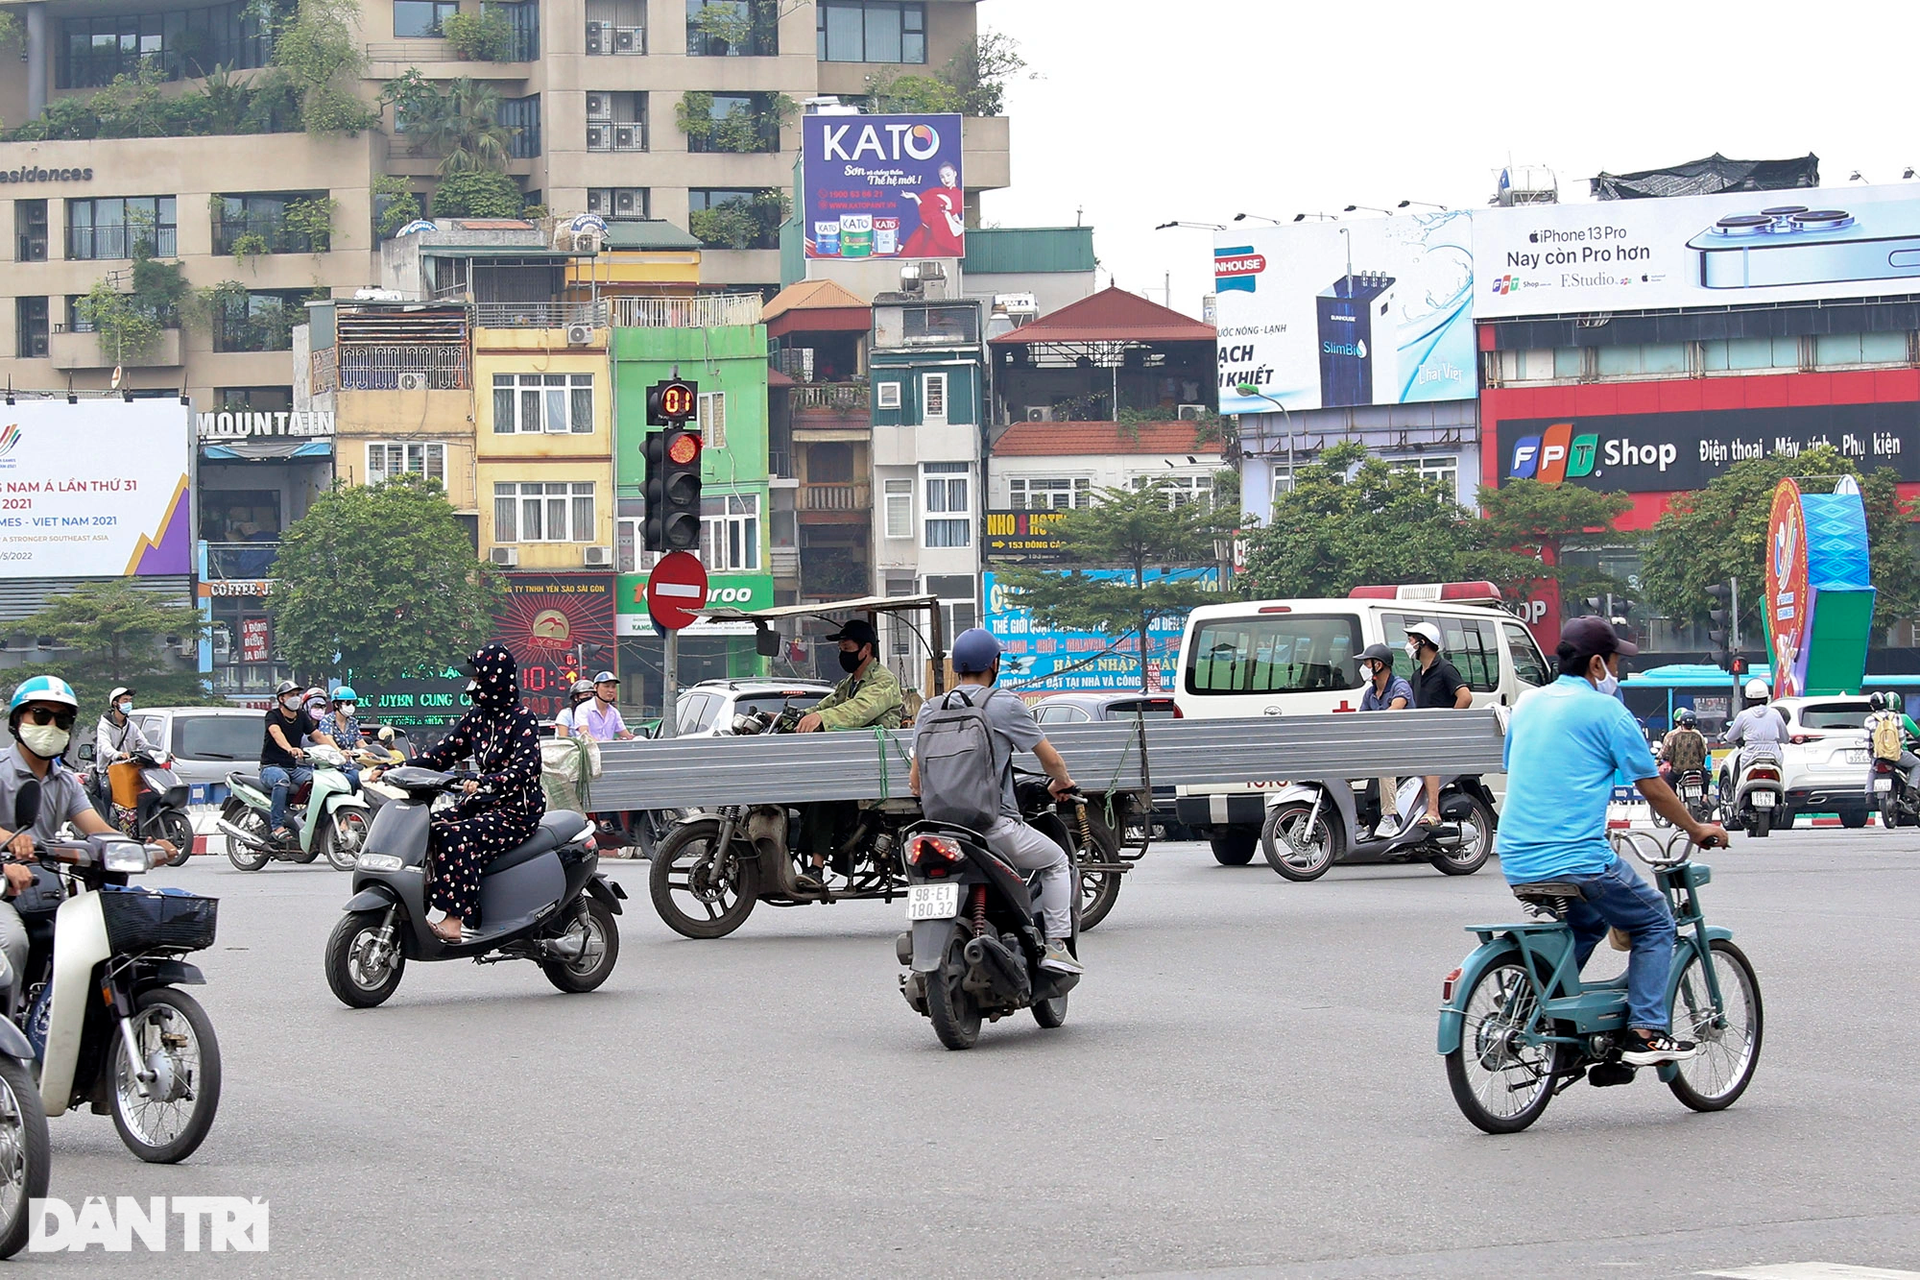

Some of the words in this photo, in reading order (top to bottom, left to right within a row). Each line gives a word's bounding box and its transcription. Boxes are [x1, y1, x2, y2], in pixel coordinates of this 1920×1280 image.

[823, 124, 940, 160] KATO
[844, 165, 866, 176] Sơn
[843, 219, 868, 229] KATO
[1540, 229, 1585, 243] iPhone
[1588, 227, 1602, 240] 13
[1605, 226, 1627, 239] Pro
[1507, 252, 1540, 269] Nay
[1545, 247, 1577, 265] còn
[1582, 247, 1611, 262] Pro
[1617, 245, 1650, 261] hơn
[1561, 272, 1614, 287] F.Studio
[1235, 325, 1259, 336] NÓNG
[1264, 324, 1287, 336] LẠNH
[666, 390, 690, 412] 01
[197, 411, 335, 436] MOUNTAIN
[1604, 438, 1677, 472] Shop
[1700, 439, 1727, 466] Điện
[1843, 433, 1866, 460] Phụ
[1873, 432, 1900, 459] kiện
[7, 482, 40, 492] NAM
[44, 479, 56, 492] Á
[59, 477, 87, 492] LẦN
[91, 478, 121, 491] THỨ
[124, 480, 137, 491] 31
[2, 499, 32, 509] 2021
[32, 517, 59, 526] VIET
[62, 516, 89, 526] NAM
[92, 516, 117, 525] 2021
[987, 514, 1015, 535] NHO
[1018, 514, 1027, 535] 9
[1008, 541, 1023, 549] 153
[546, 584, 559, 592] YẾN
[992, 615, 1008, 634] THẾ
[1010, 616, 1027, 633] GIỚI
[1098, 656, 1138, 673] NHẬP
[1066, 676, 1079, 689] TẠI
[1081, 675, 1100, 688] NHÀ
[1102, 675, 1114, 686] VÀ
[1116, 673, 1142, 686] CÔNG
[915, 887, 950, 901] 98-E1
[911, 902, 953, 917] 180.32
